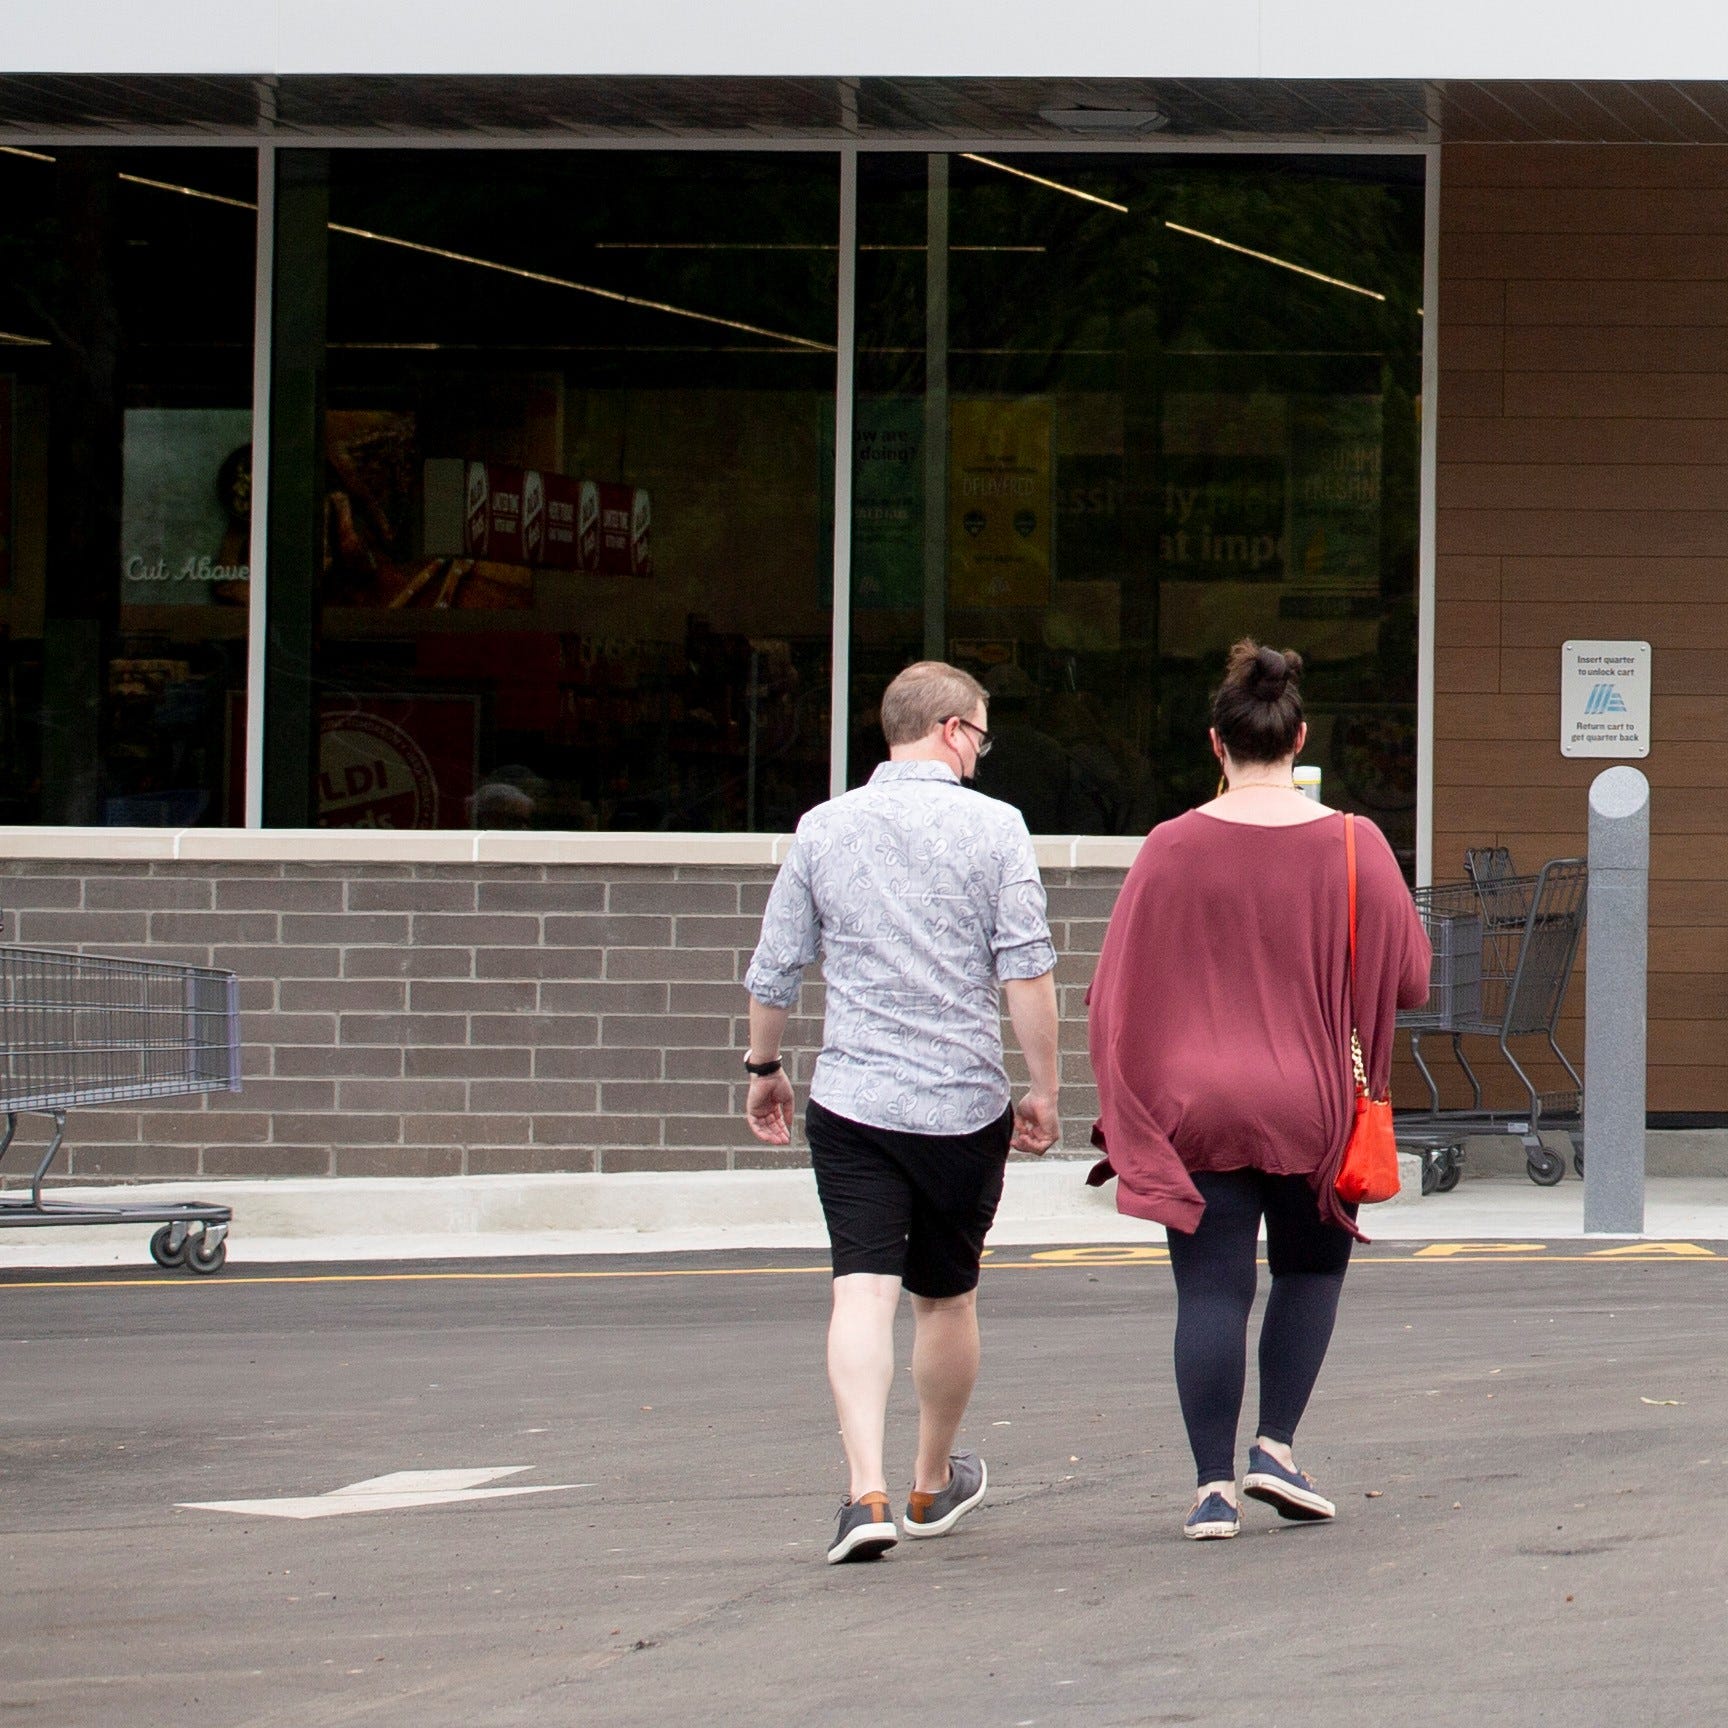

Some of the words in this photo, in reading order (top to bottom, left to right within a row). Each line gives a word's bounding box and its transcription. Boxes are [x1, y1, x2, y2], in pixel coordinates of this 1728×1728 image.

[126, 555, 168, 581] Cut
[1577, 656, 1602, 664] Insert
[1578, 668, 1586, 676] to
[1588, 668, 1615, 676] unlock
[1607, 722, 1624, 730] cart
[1626, 722, 1635, 730] to
[1571, 734, 1585, 742] get
[1586, 734, 1617, 742] quarter
[1619, 733, 1639, 742] back
